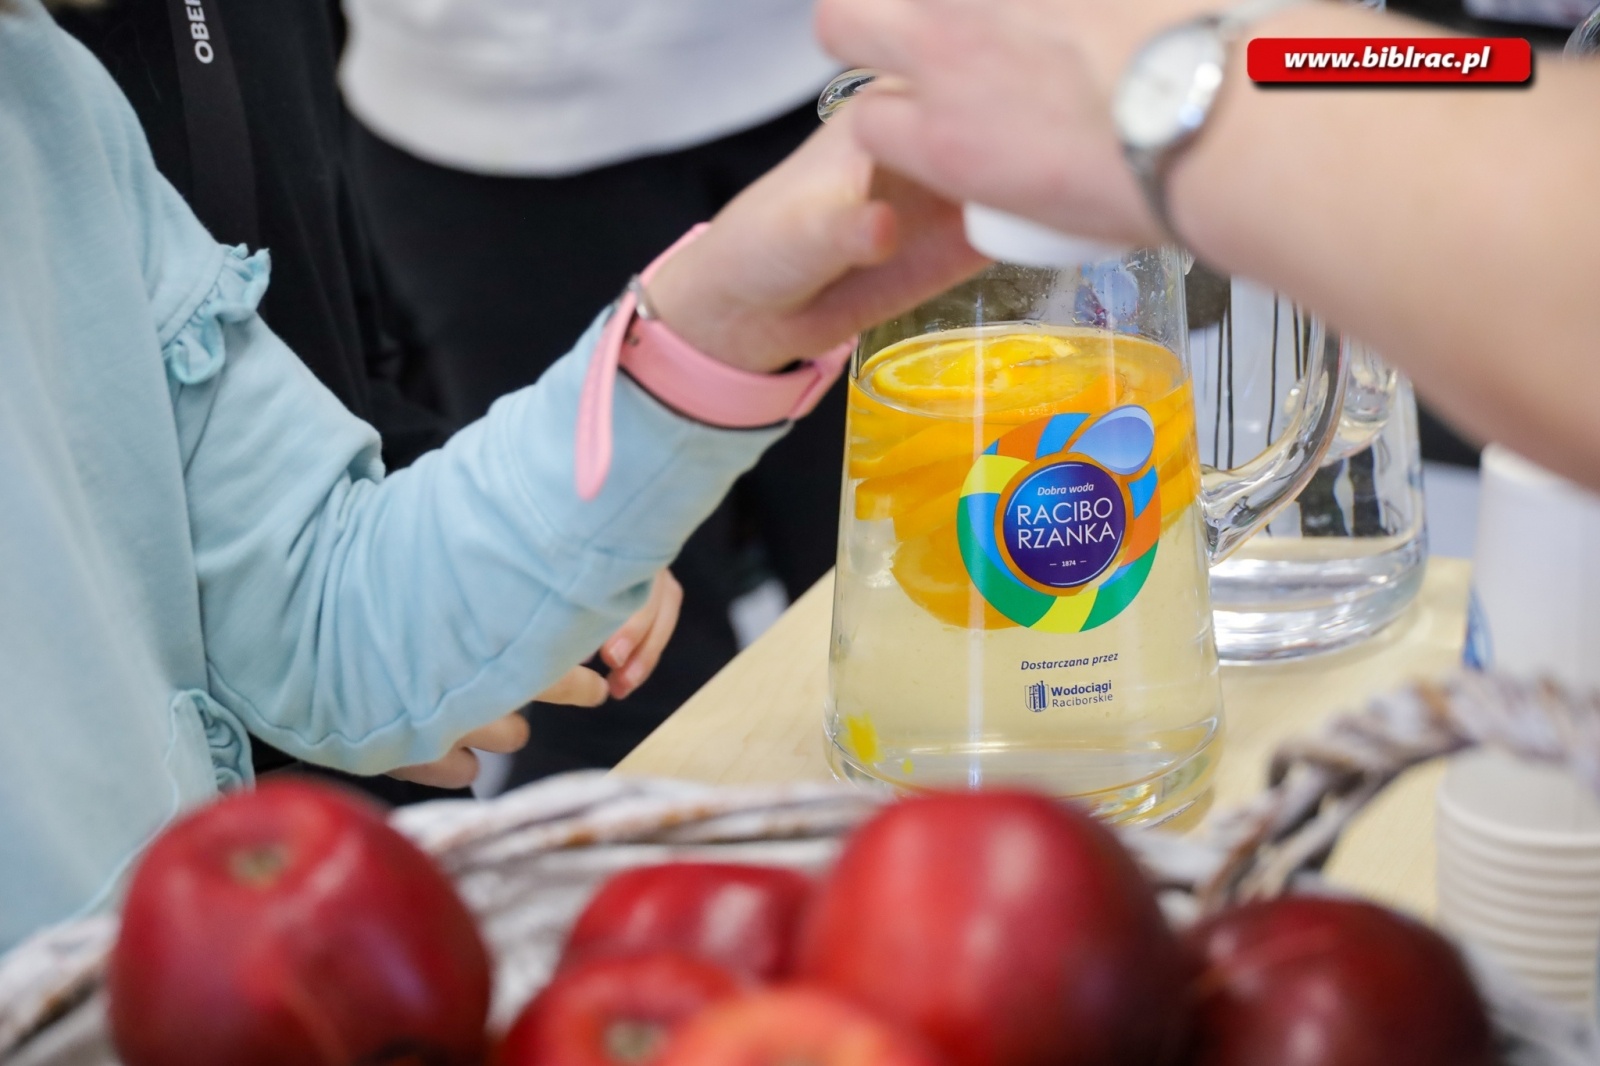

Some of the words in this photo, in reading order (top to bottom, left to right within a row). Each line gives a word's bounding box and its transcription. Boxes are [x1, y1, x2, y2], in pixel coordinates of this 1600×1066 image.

[1037, 486, 1066, 496] Dobra
[1069, 482, 1094, 494] woda
[1017, 497, 1113, 526] RACIBO
[1018, 521, 1116, 550] RZANKA
[1021, 657, 1089, 670] Dostarczana
[1091, 653, 1119, 666] przez
[1051, 680, 1112, 697] Wodociągi
[1052, 693, 1113, 708] Raciborskie
